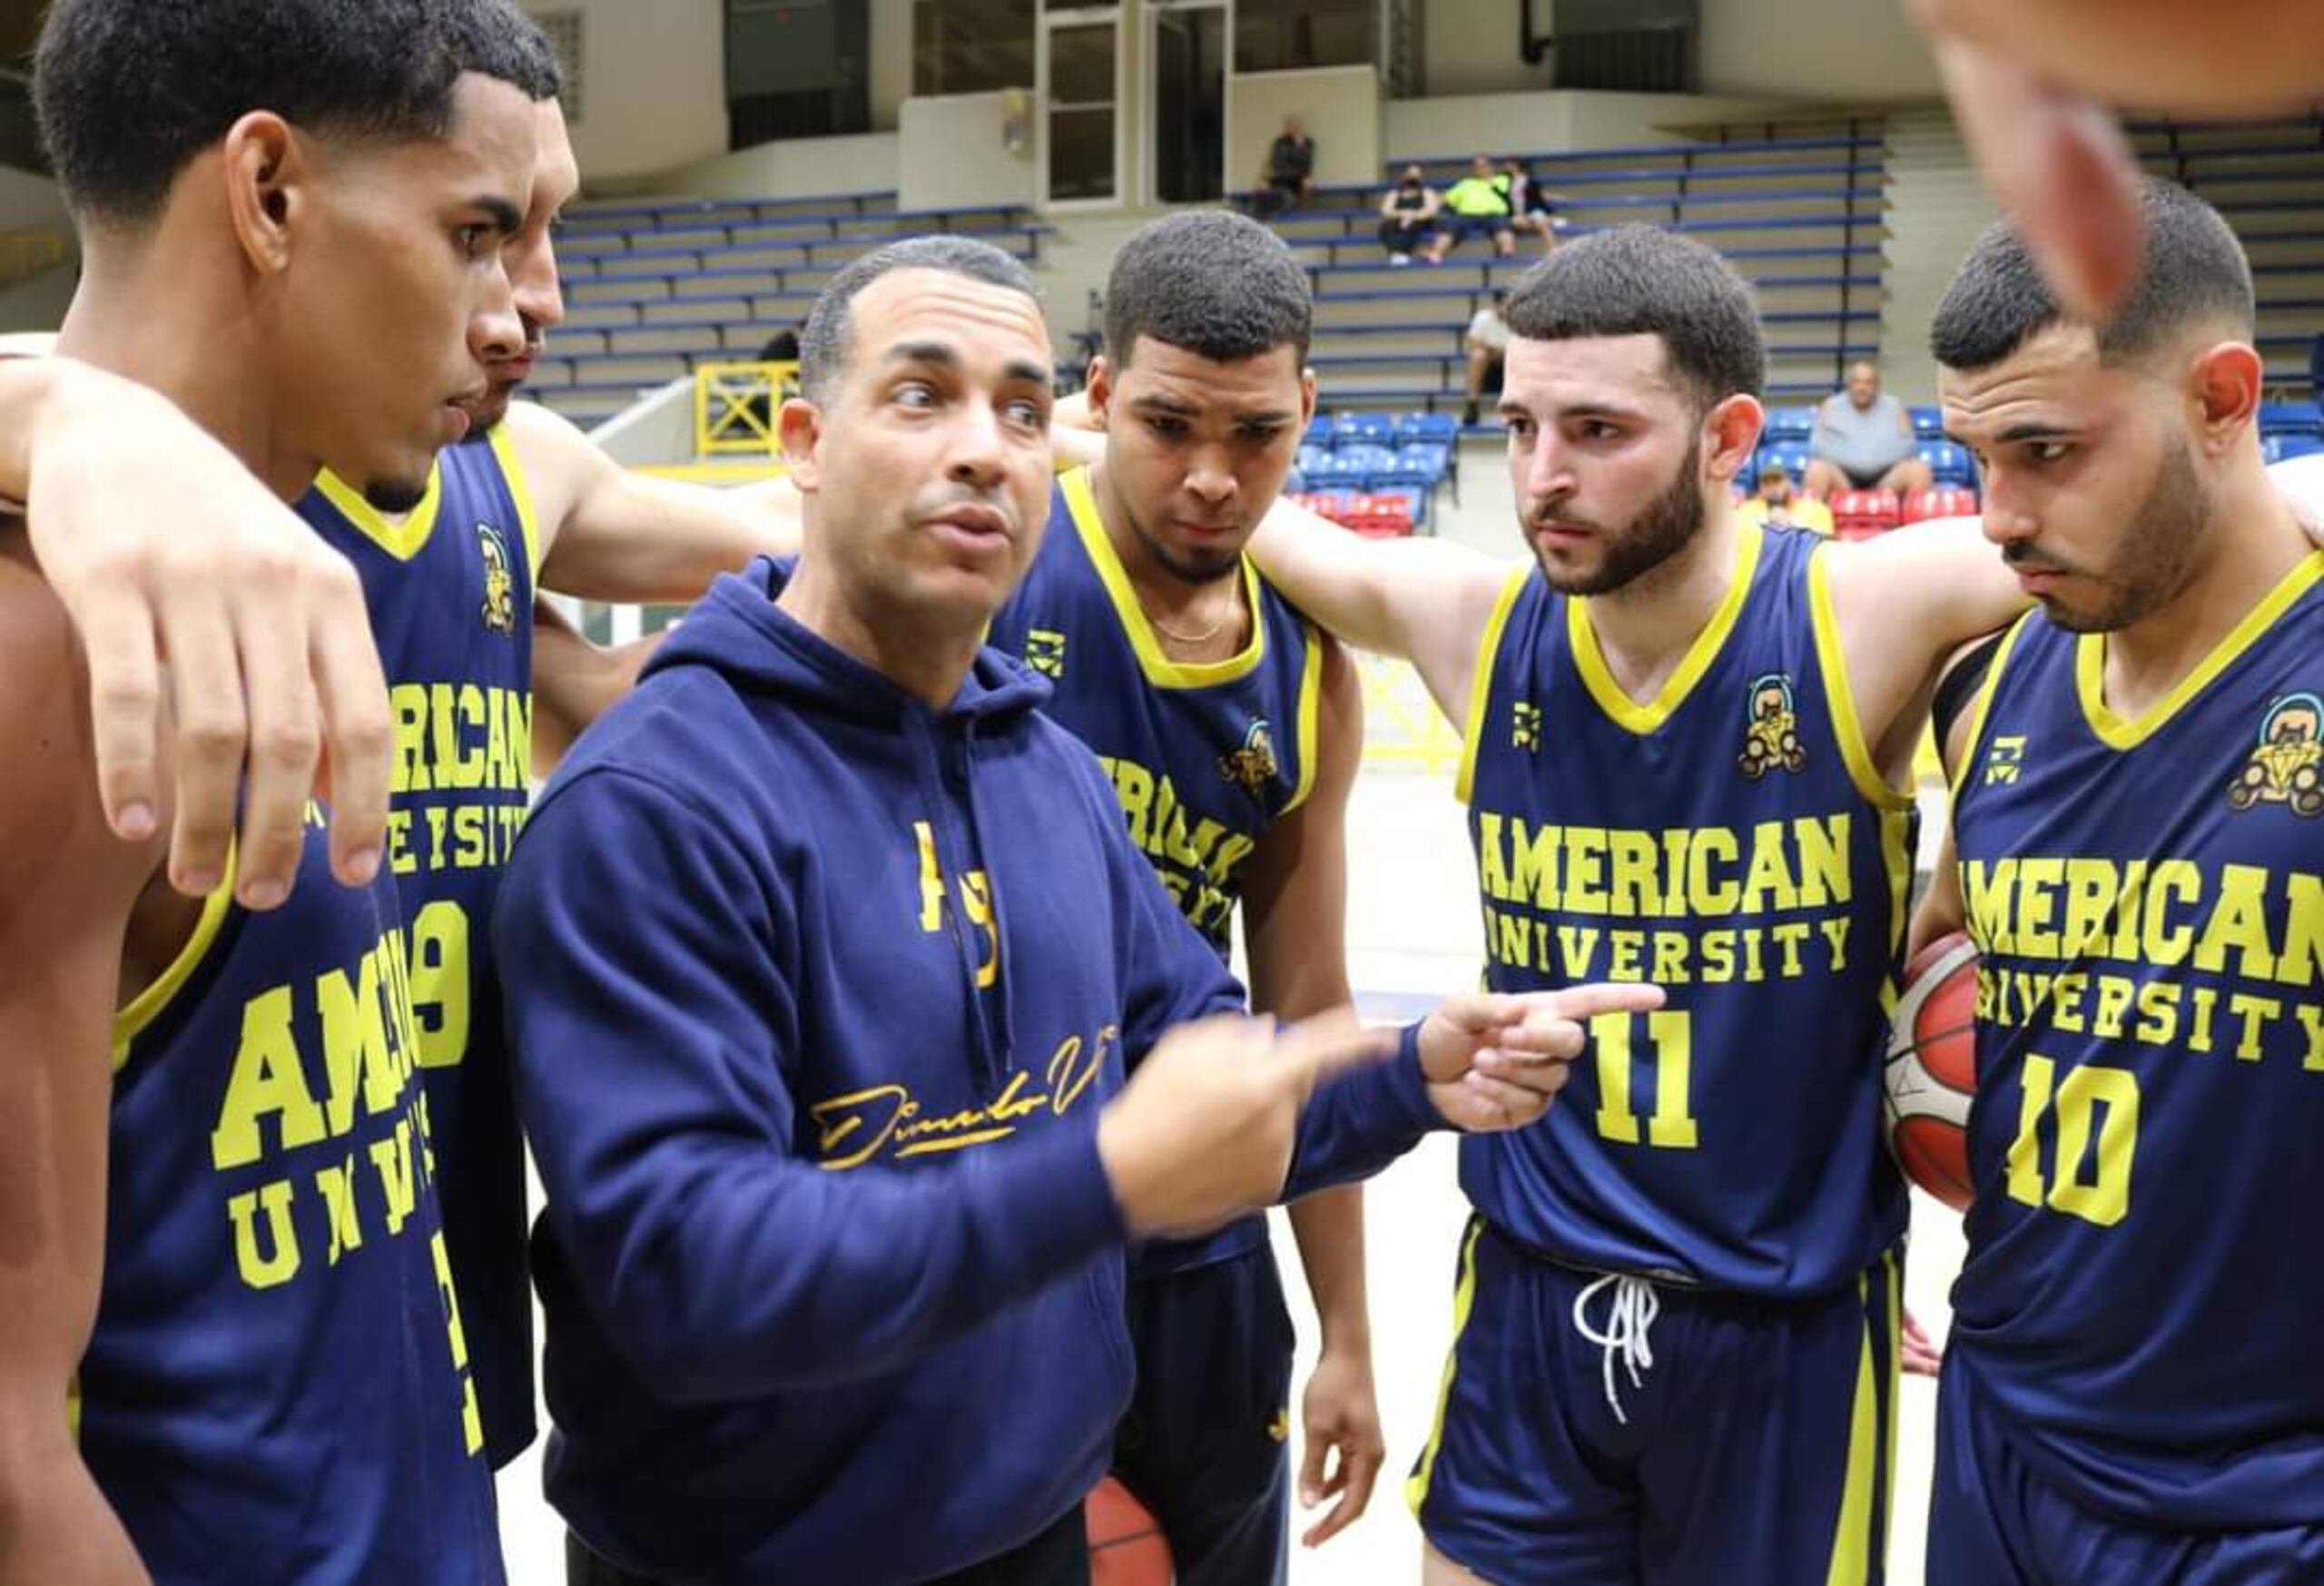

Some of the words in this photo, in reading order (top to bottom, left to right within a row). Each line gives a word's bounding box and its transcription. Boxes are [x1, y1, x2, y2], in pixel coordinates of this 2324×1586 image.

[389, 683, 533, 793] RICAN
[1480, 812, 1851, 918] AMERICAN
[1959, 857, 2324, 987] MERICAN
[1590, 1010, 1699, 1148] 11
[1975, 966, 2324, 1072] NIVERSITY
[2004, 1052, 2141, 1226] 10
